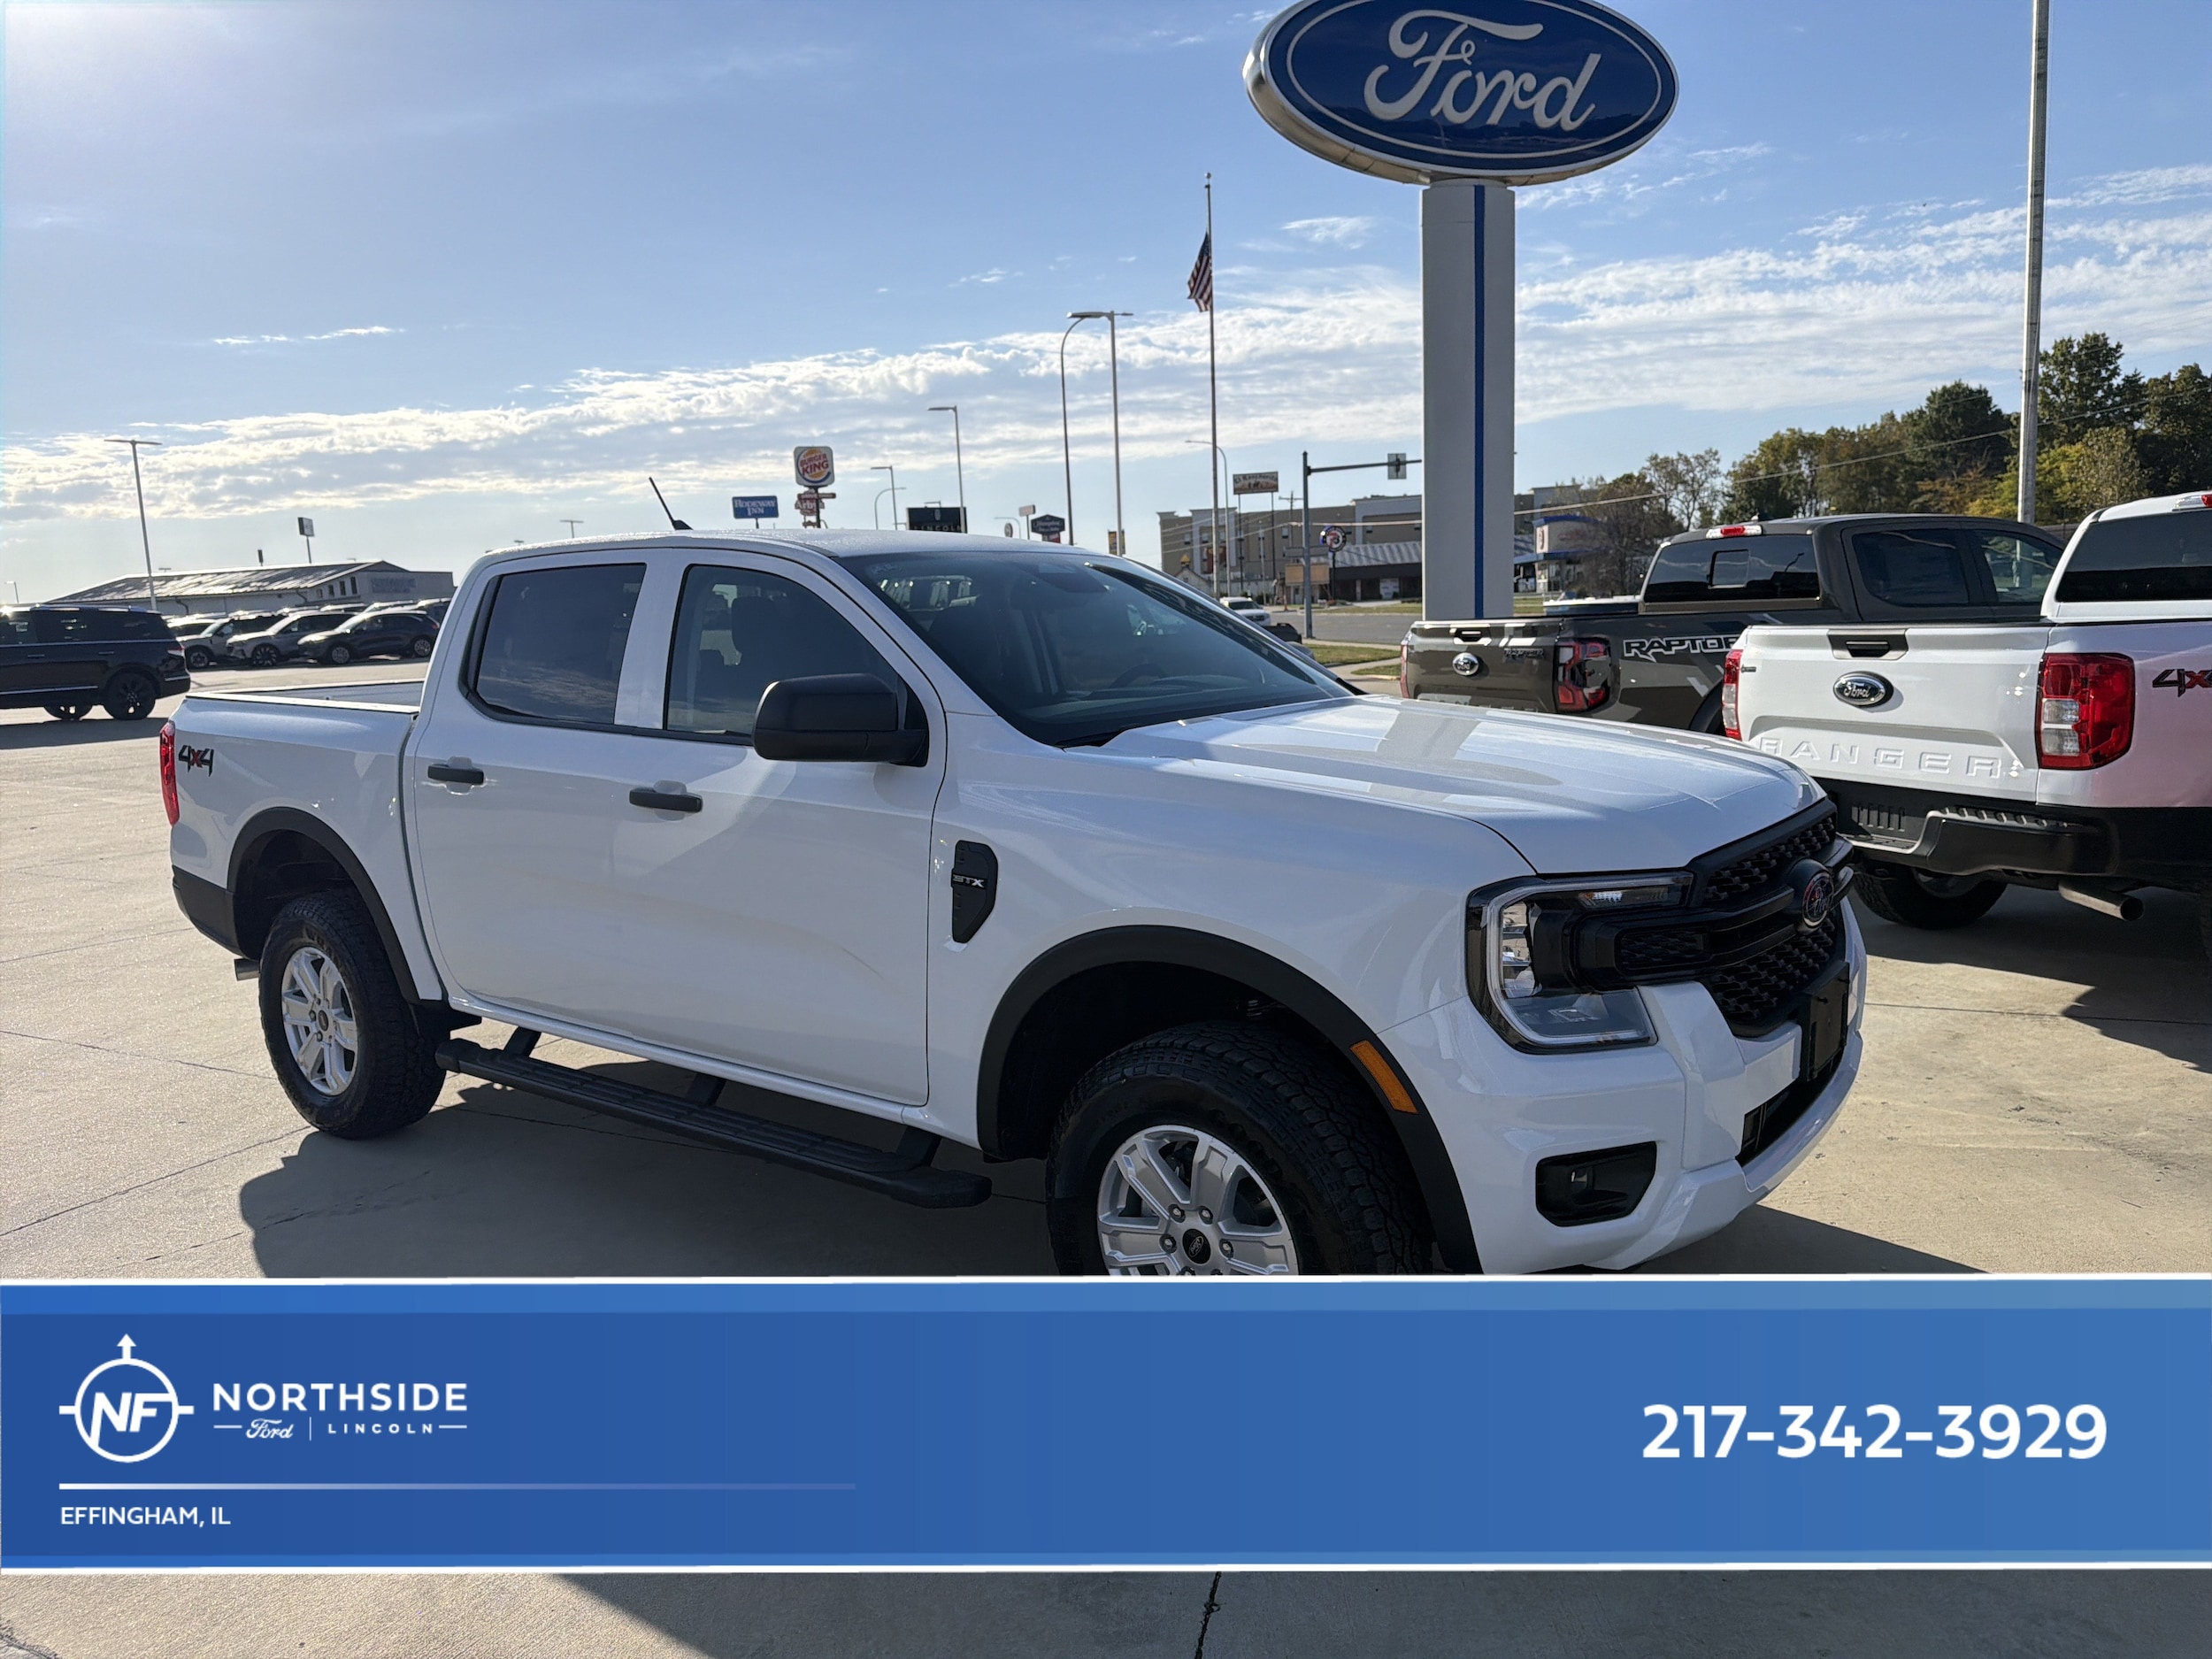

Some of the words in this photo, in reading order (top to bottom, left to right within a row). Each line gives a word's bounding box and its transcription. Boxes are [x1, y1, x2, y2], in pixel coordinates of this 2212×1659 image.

[1364, 10, 1601, 131] Ford
[800, 453, 828, 467] BURGER
[802, 460, 829, 476] KING
[1623, 634, 1741, 663] RAPTOR
[1843, 680, 1872, 698] Ford
[1759, 737, 2002, 780] RANGER
[952, 874, 985, 888] STX
